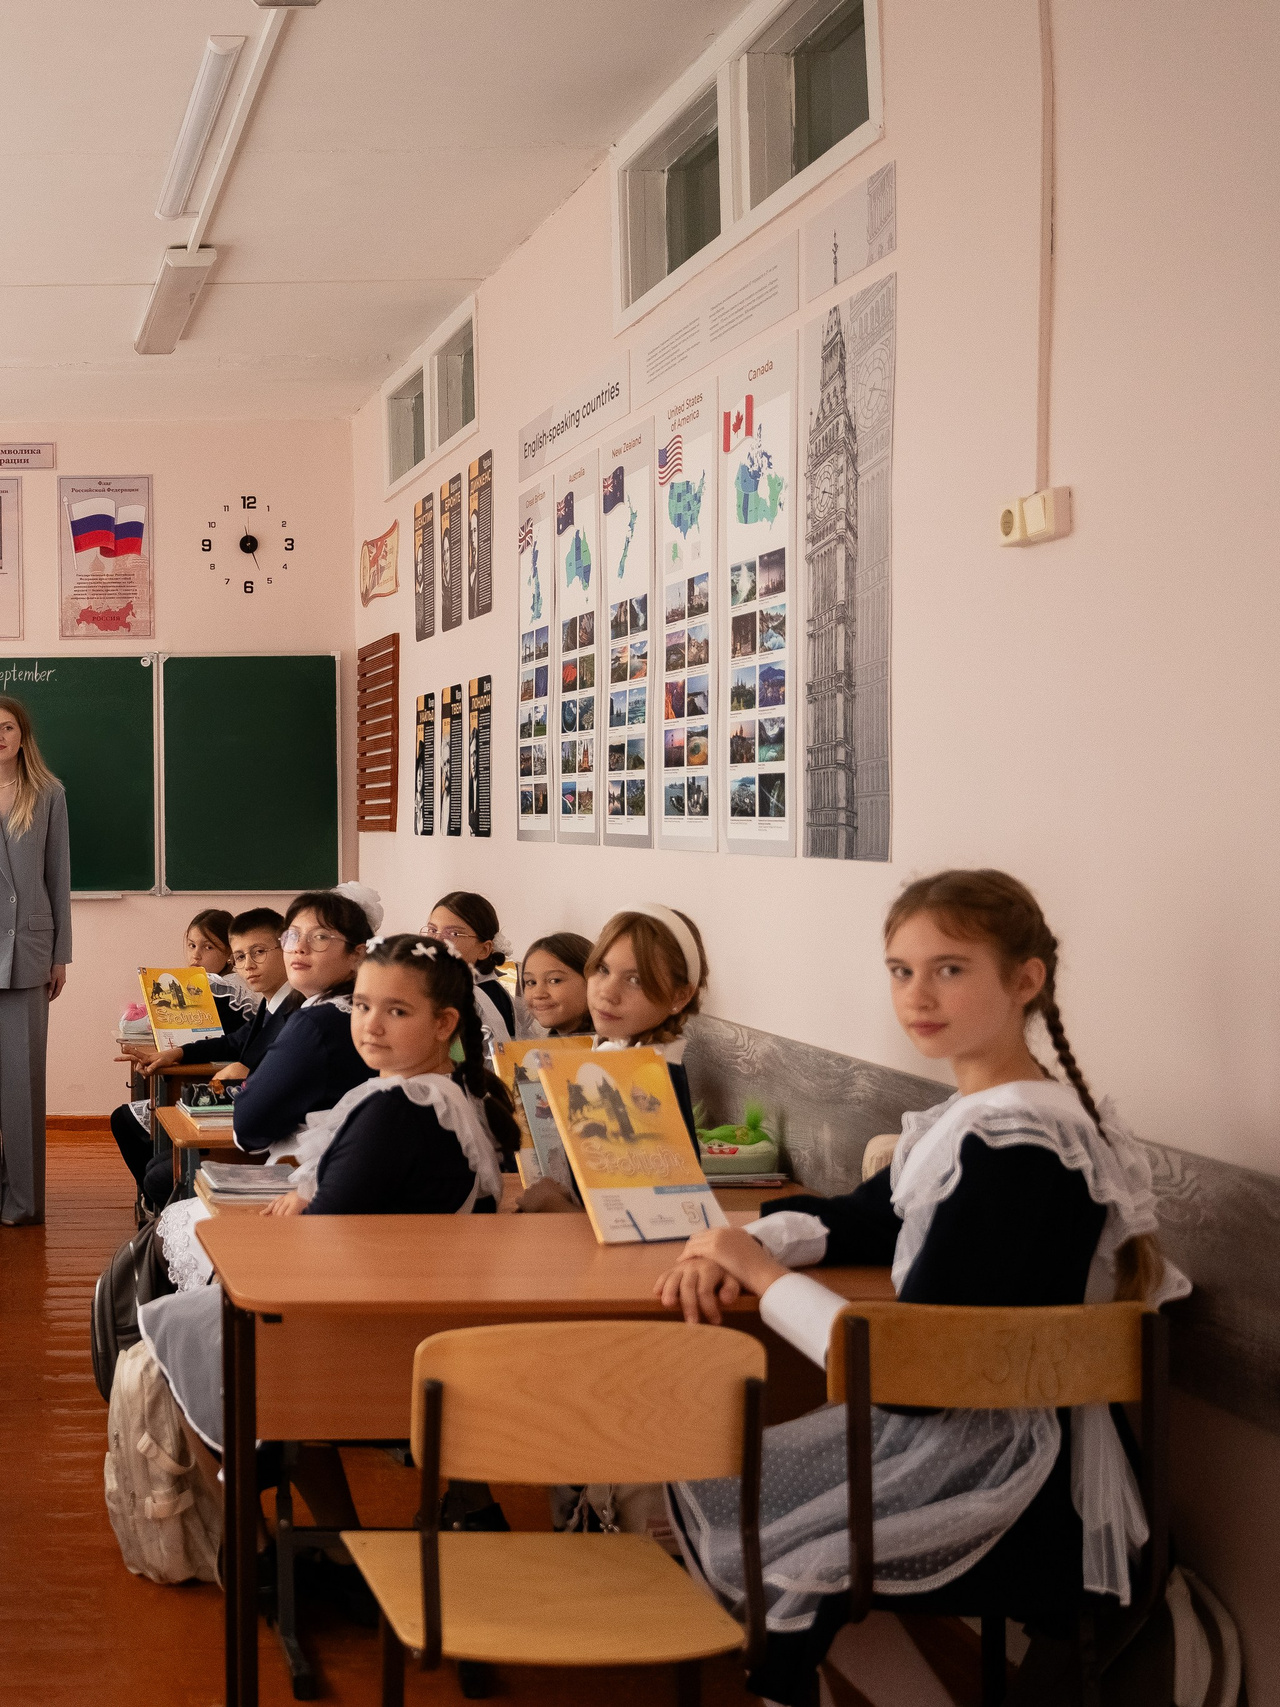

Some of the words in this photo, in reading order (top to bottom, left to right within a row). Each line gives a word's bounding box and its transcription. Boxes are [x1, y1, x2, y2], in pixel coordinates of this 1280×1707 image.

[748, 359, 773, 382] Canada
[667, 400, 685, 420] United
[686, 392, 703, 410] States
[523, 411, 580, 460] English-speaking
[581, 381, 620, 419] countries
[671, 419, 677, 432] of
[677, 409, 700, 430] America
[611, 446, 622, 459] New
[623, 434, 642, 455] Zealand
[568, 466, 585, 483] Australia
[107, 486, 139, 494] Федерации
[241, 495, 257, 509] 12
[208, 521, 216, 529] 10
[281, 520, 287, 528] 2
[201, 539, 212, 552] 9
[284, 538, 295, 551] 3
[243, 580, 254, 593] 6
[266, 577, 273, 585] 5
[156, 1008, 215, 1026] Spotlight
[681, 1201, 701, 1225] 5
